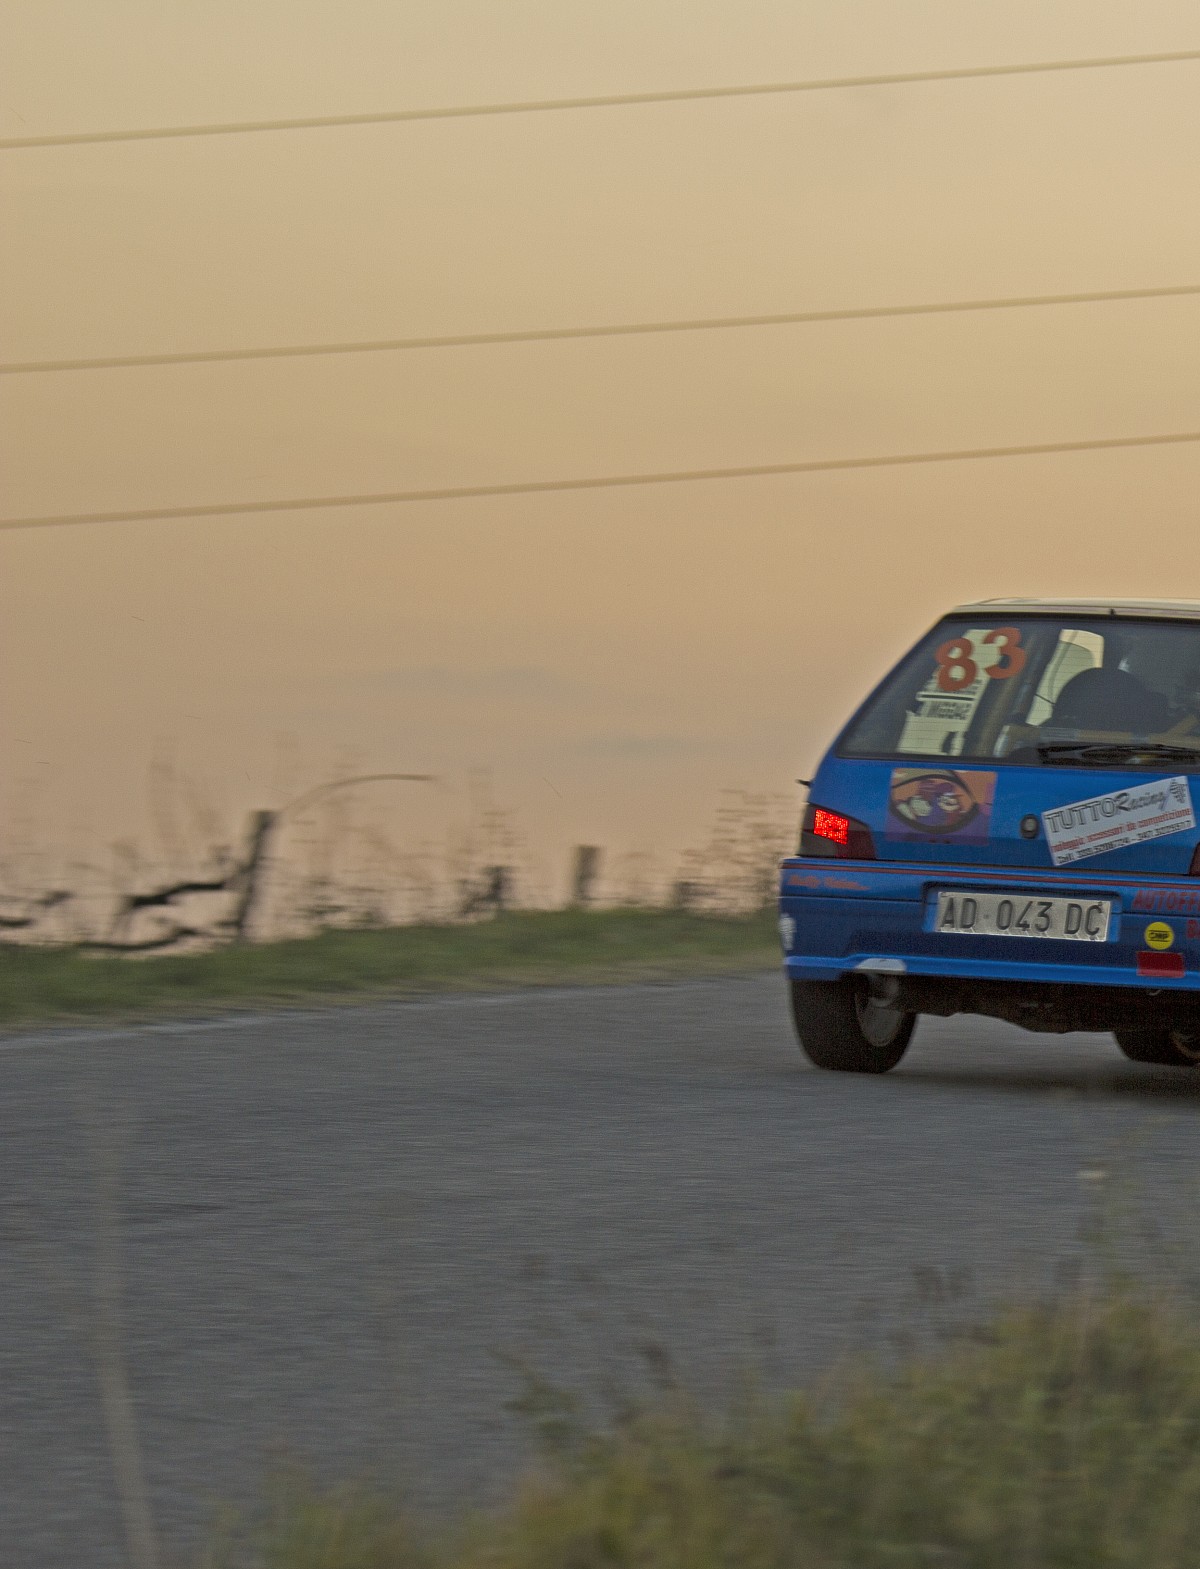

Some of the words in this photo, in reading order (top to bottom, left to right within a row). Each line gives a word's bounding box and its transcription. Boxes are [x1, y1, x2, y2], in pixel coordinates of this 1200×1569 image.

[934, 626, 1027, 691] 83
[940, 897, 977, 929] AD
[996, 899, 1053, 932] 043
[1064, 902, 1102, 936] DC
